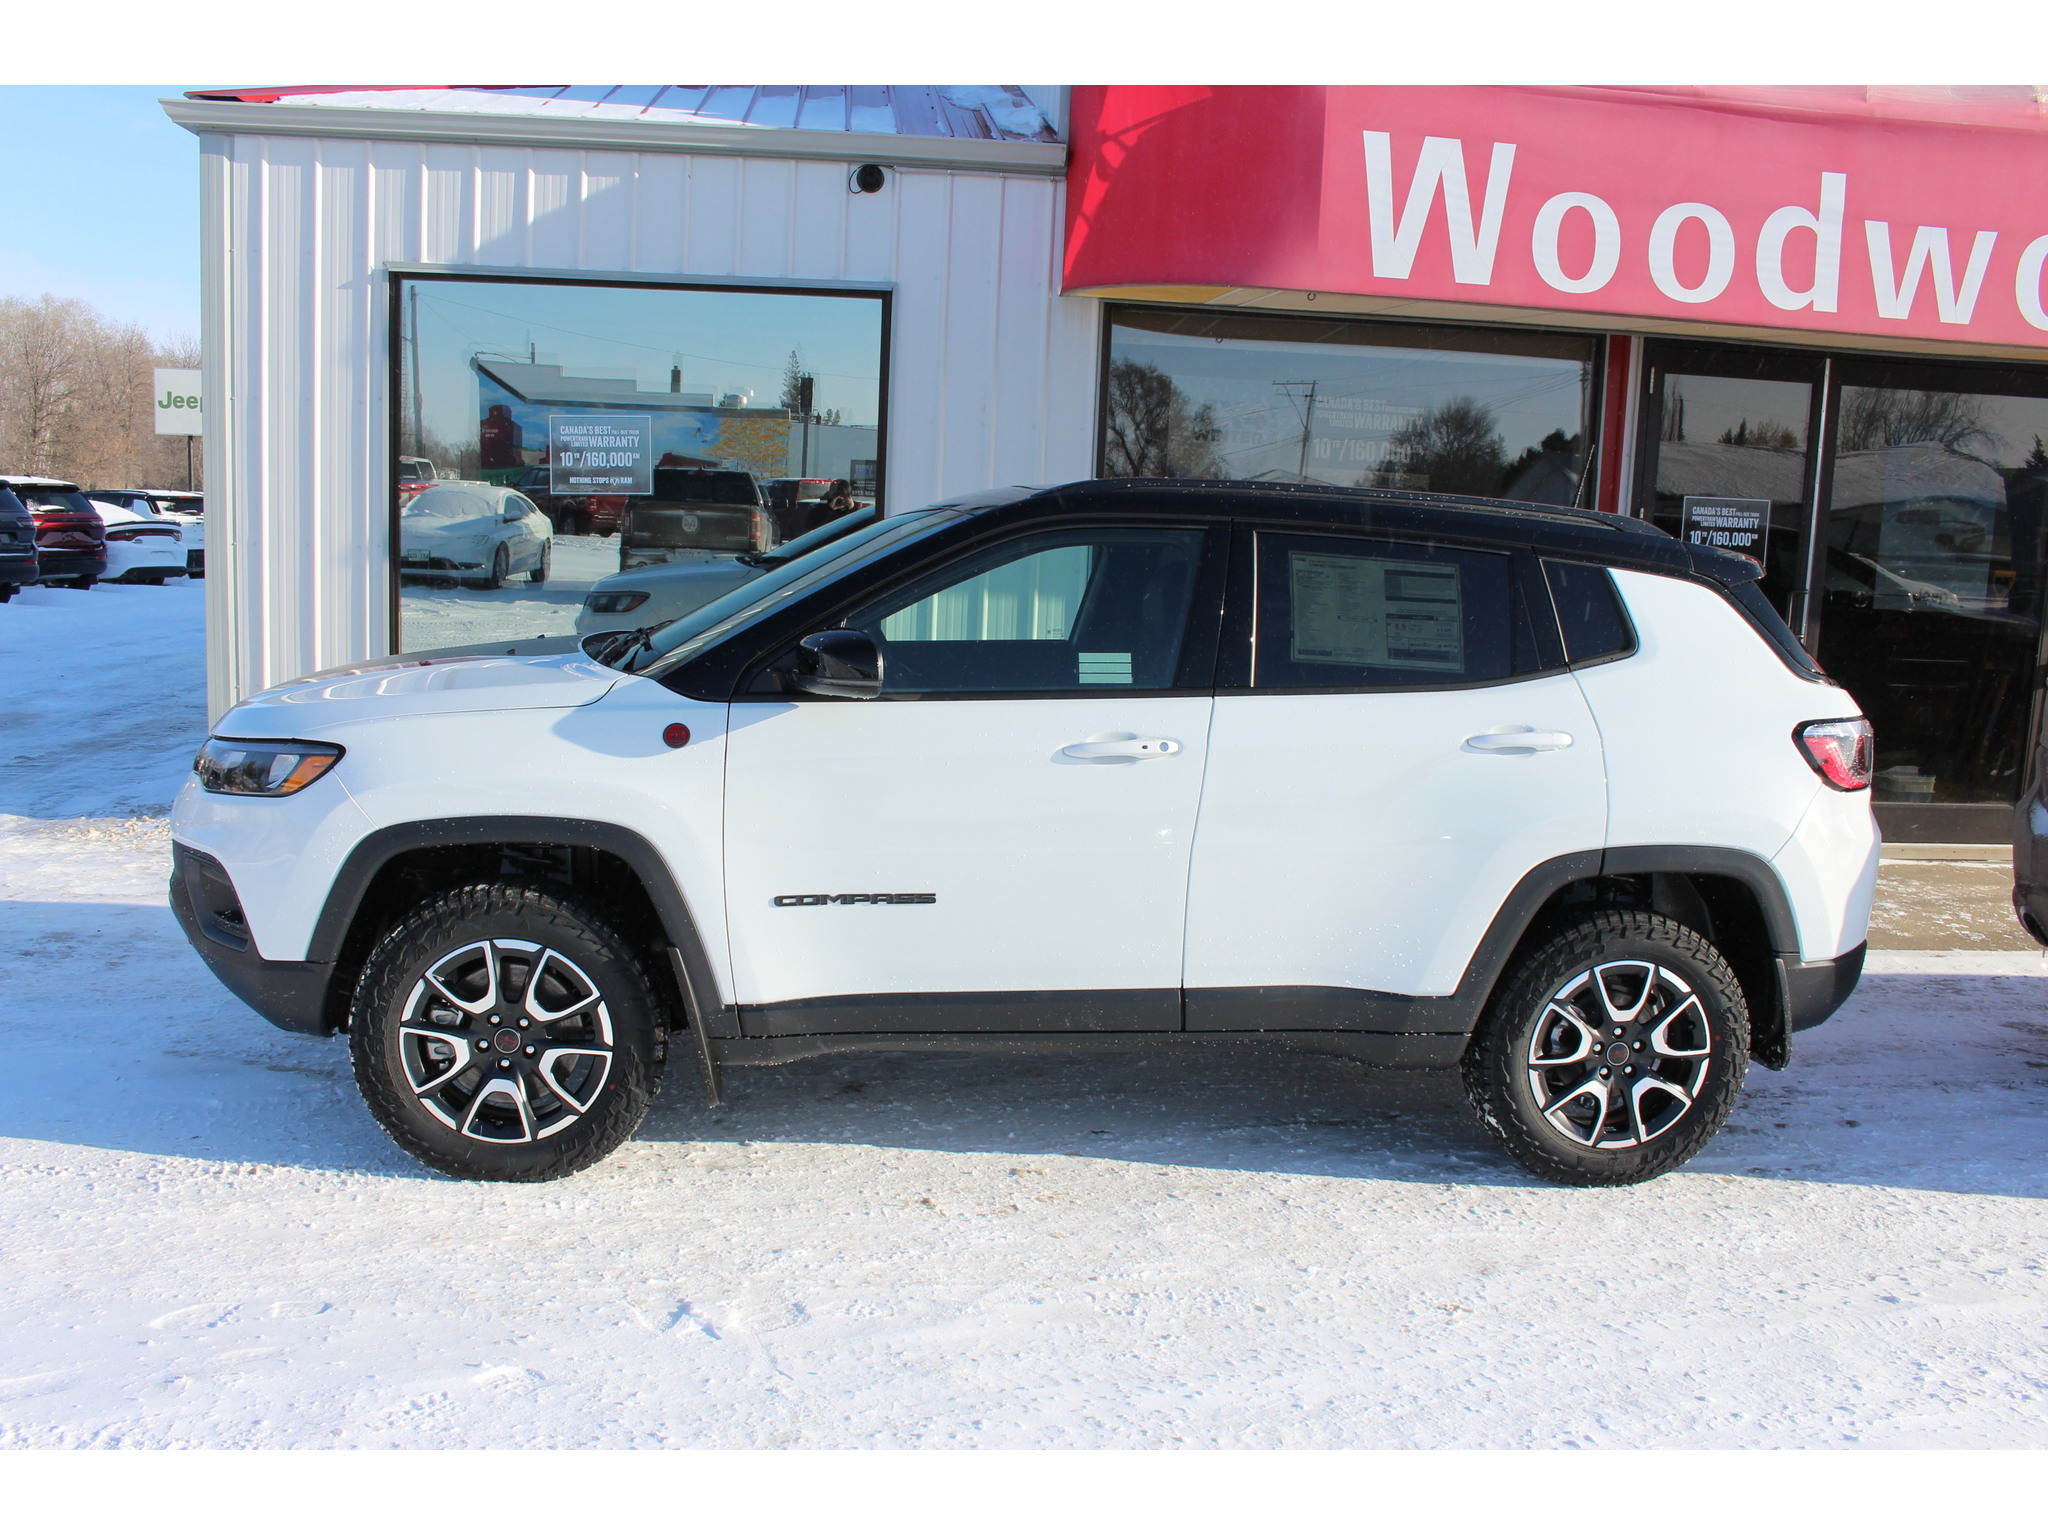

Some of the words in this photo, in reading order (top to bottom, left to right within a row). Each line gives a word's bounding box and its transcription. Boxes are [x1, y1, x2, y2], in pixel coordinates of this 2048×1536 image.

[157, 391, 202, 413] Jee
[1316, 396, 1363, 411] CANADA'S
[1364, 398, 1387, 412] BEST
[1354, 412, 1424, 432] WARRANTY
[560, 426, 593, 435] CANADA'S
[595, 426, 612, 435] BEST
[589, 436, 640, 448] WARRANTY
[1692, 506, 1720, 515] CANADA'S
[1721, 508, 1736, 516] BEST
[1716, 517, 1759, 529] WARRANTY
[774, 893, 937, 907] COMPASS
